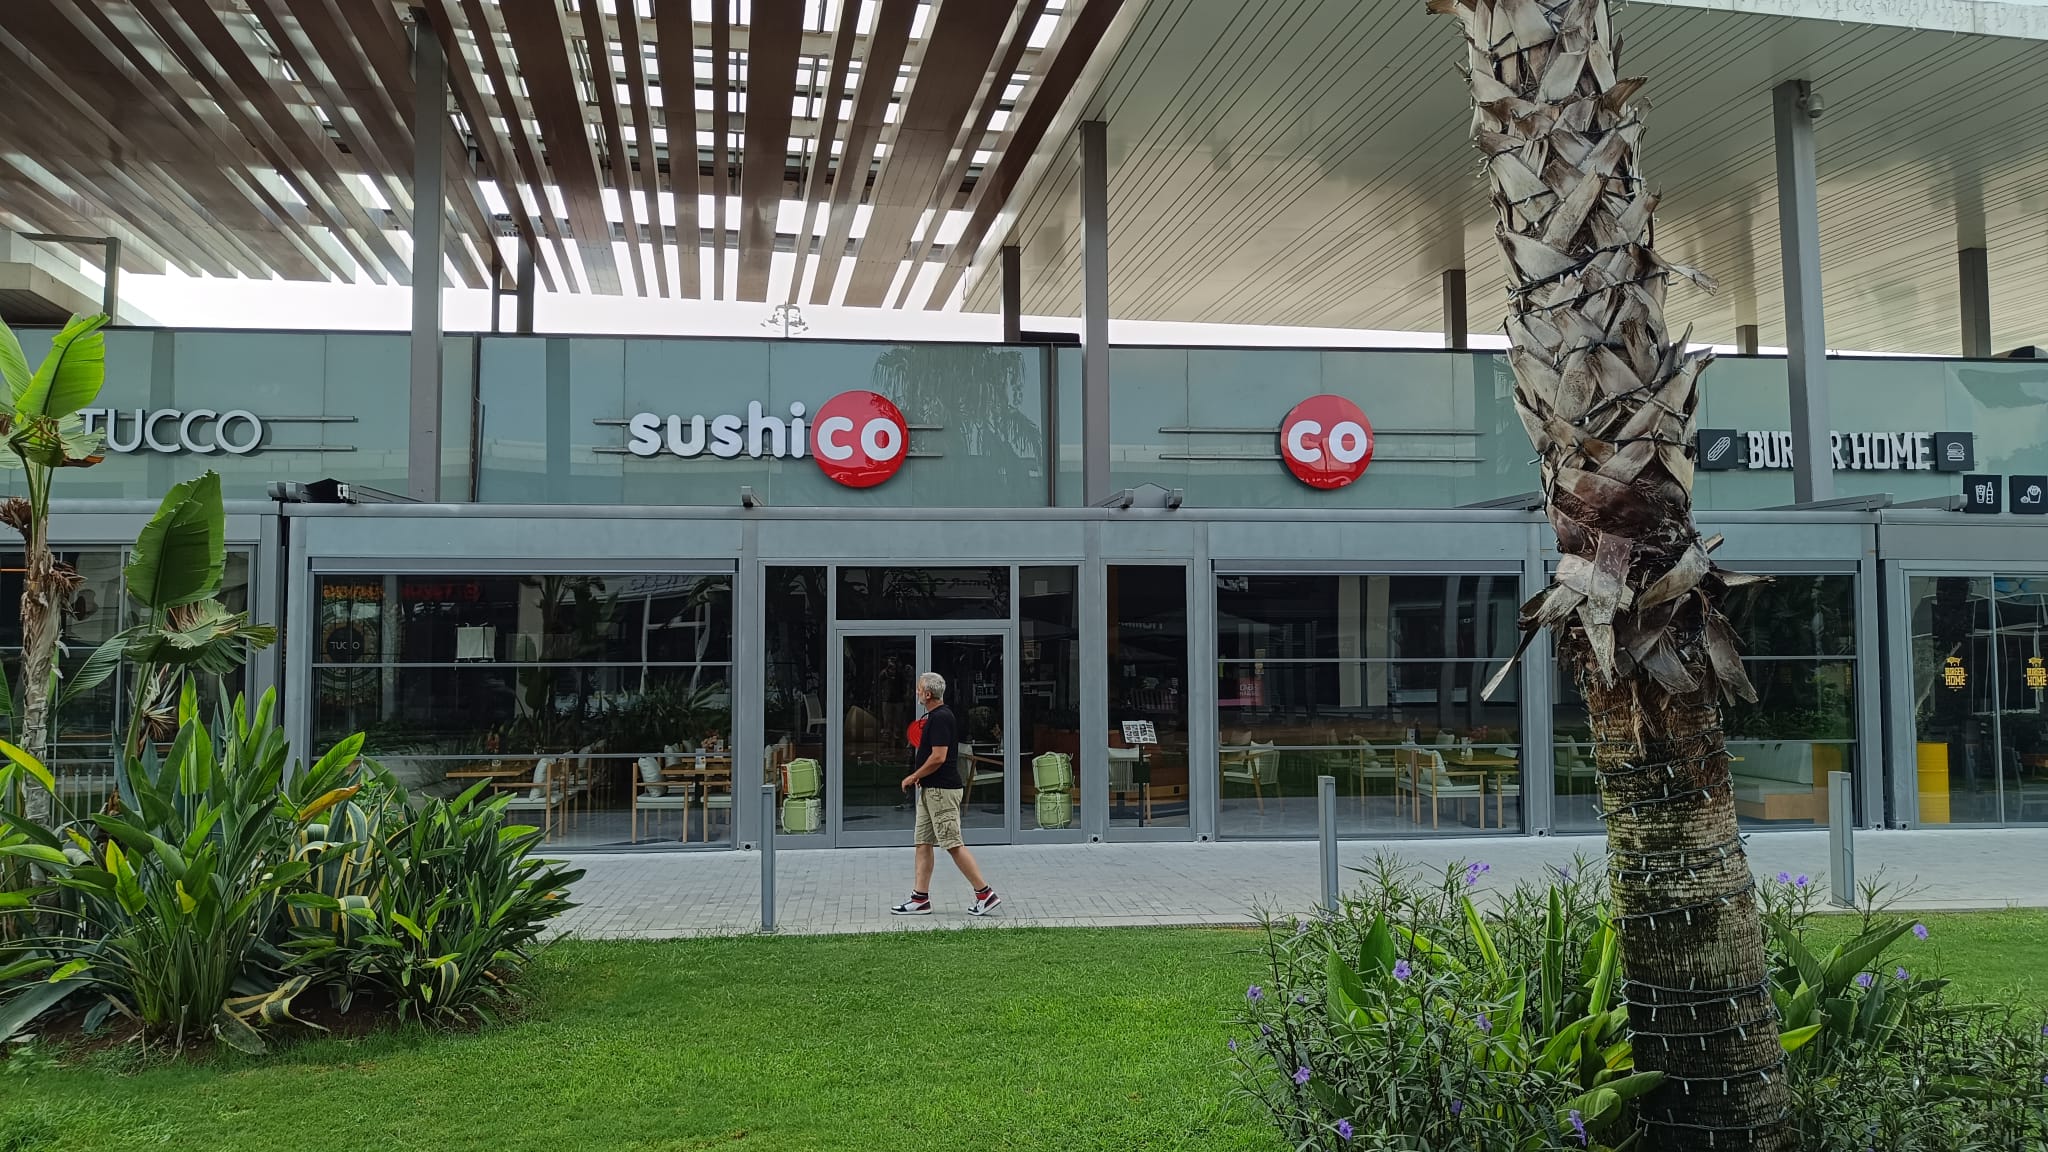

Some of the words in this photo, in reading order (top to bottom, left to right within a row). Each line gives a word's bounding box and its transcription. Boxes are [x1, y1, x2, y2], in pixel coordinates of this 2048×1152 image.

[77, 408, 262, 453] TUCCO
[1748, 430, 1846, 470] BURR
[1850, 432, 1931, 470] HOME
[329, 641, 360, 650] TUCO
[1945, 676, 1966, 686] HOME
[2027, 676, 2048, 686] HOME
